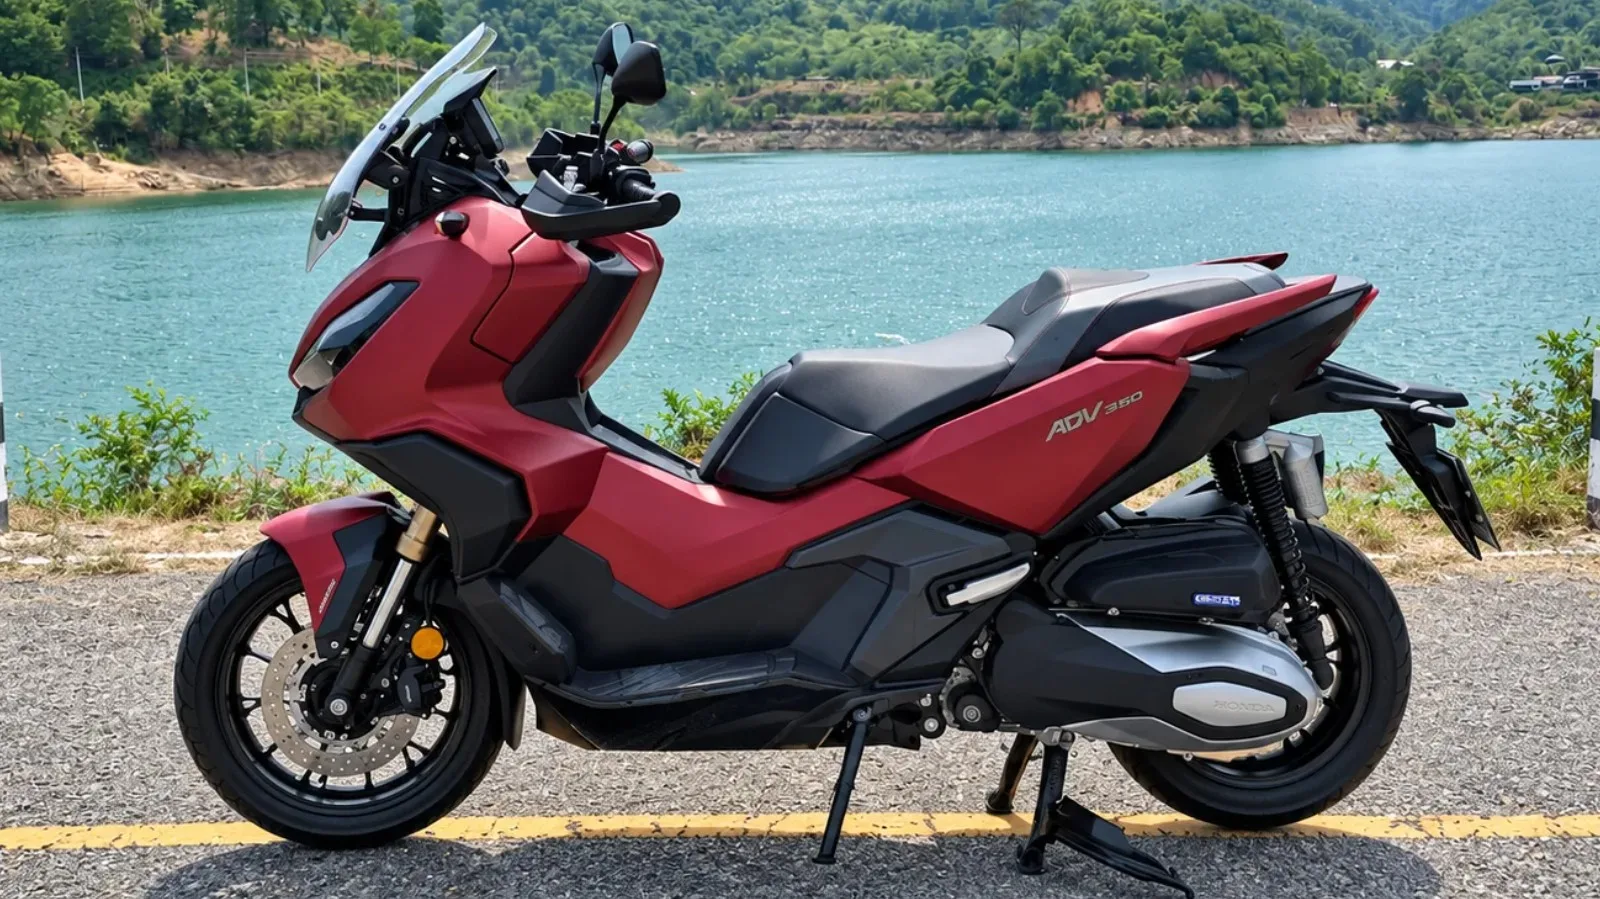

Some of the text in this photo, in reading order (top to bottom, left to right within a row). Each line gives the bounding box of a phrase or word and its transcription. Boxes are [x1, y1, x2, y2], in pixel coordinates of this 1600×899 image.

[1045, 390, 1143, 442] ADV 350
[1213, 699, 1275, 713] HONDA
